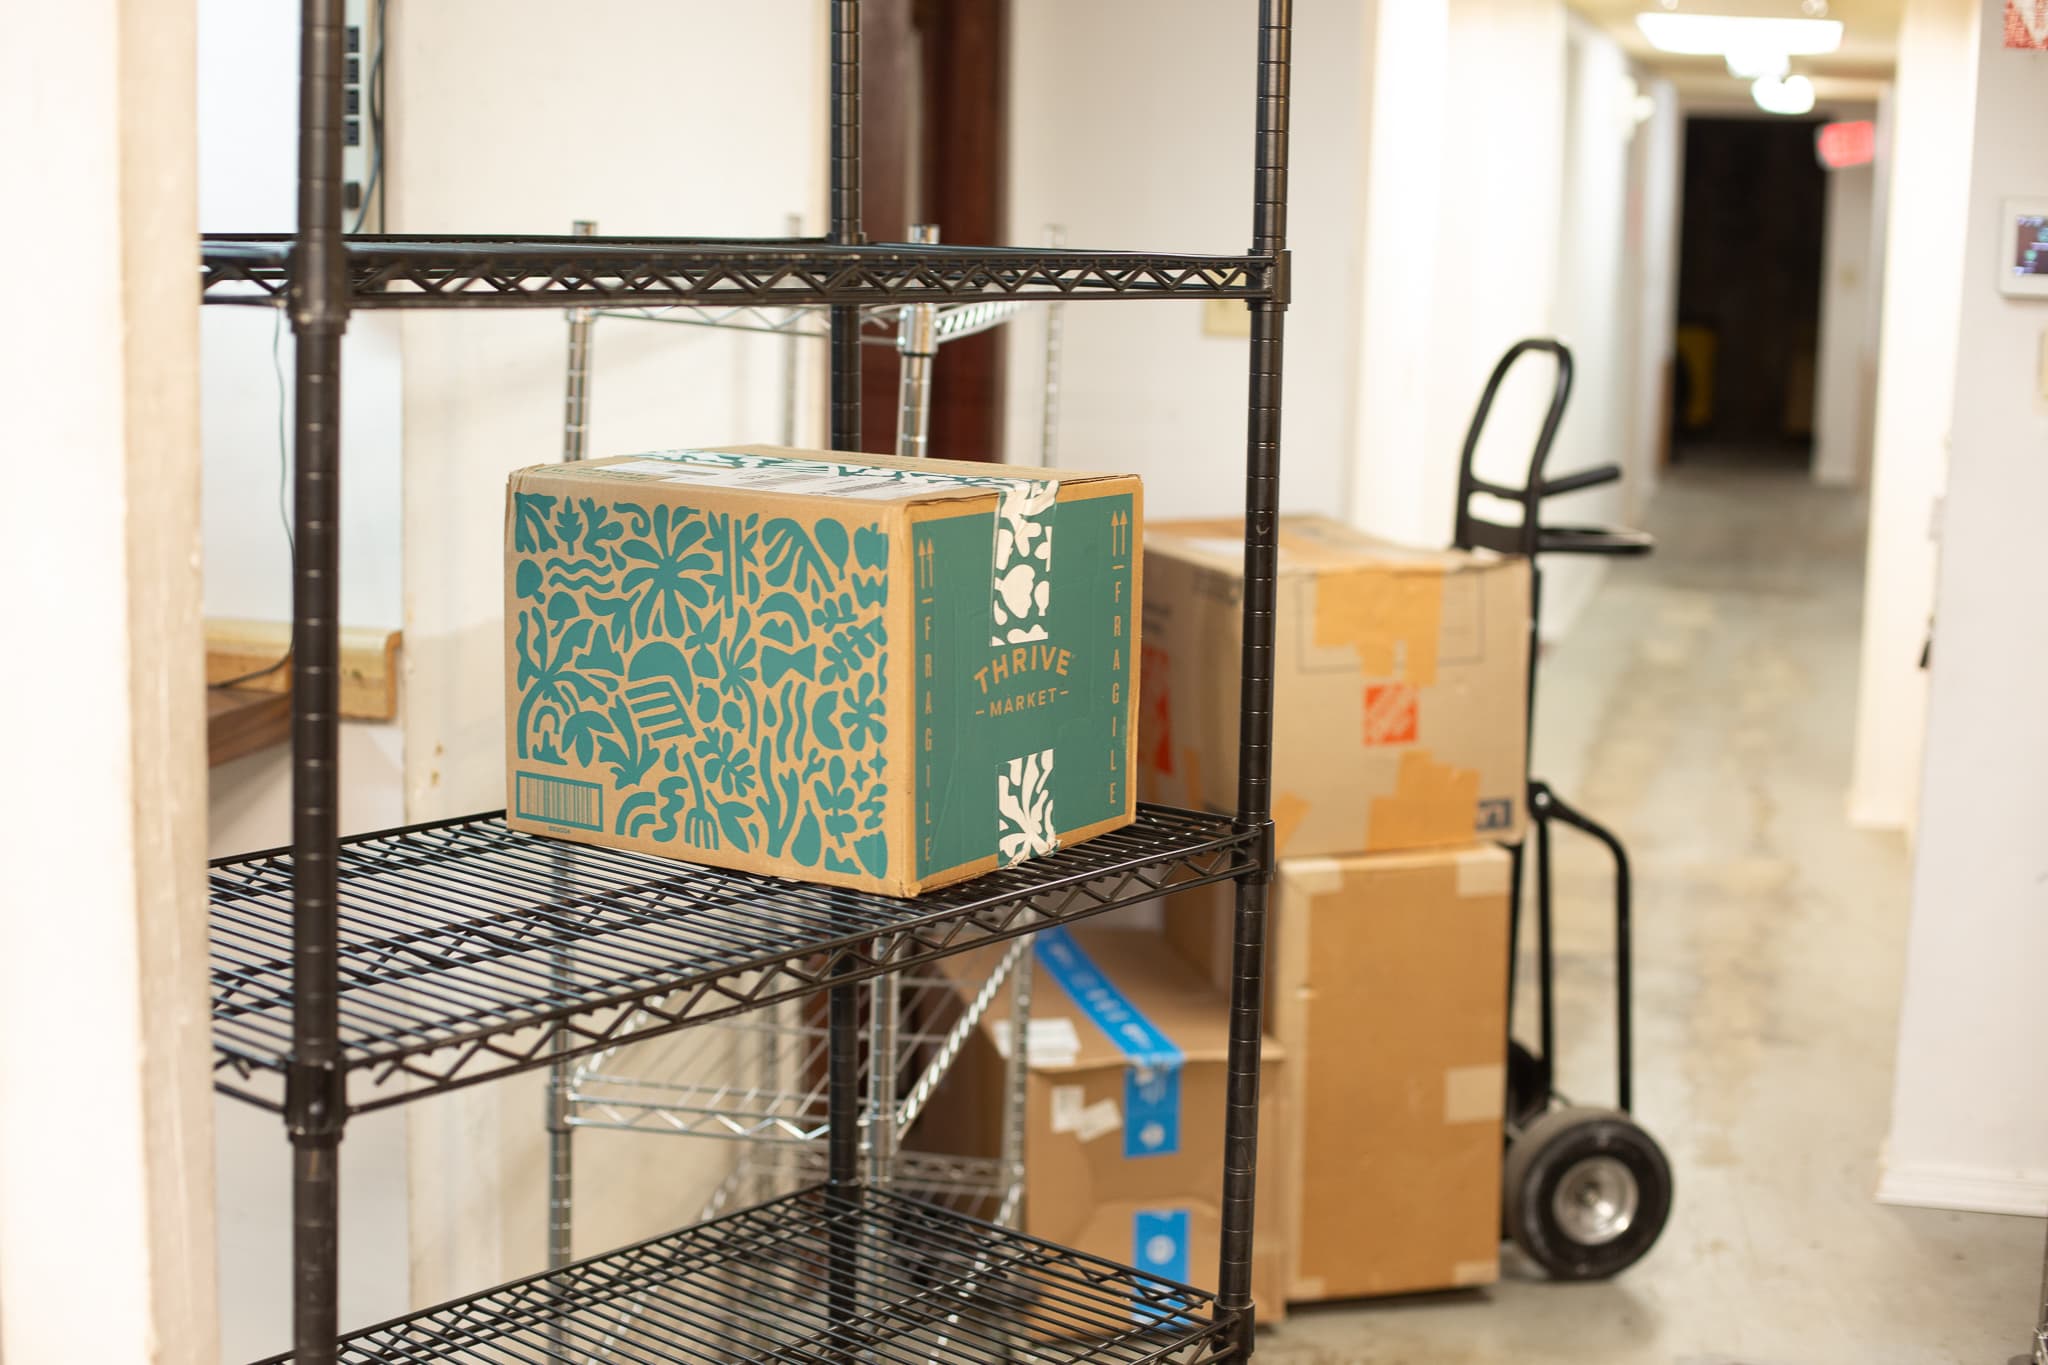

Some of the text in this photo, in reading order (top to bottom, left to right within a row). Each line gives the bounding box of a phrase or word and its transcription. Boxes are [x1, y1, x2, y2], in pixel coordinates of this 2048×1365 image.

[974, 645, 1071, 694] THRIVE
[990, 688, 1057, 717] MARKET
[1110, 581, 1121, 804] FRAGILE
[924, 616, 933, 861] FRAGILE
